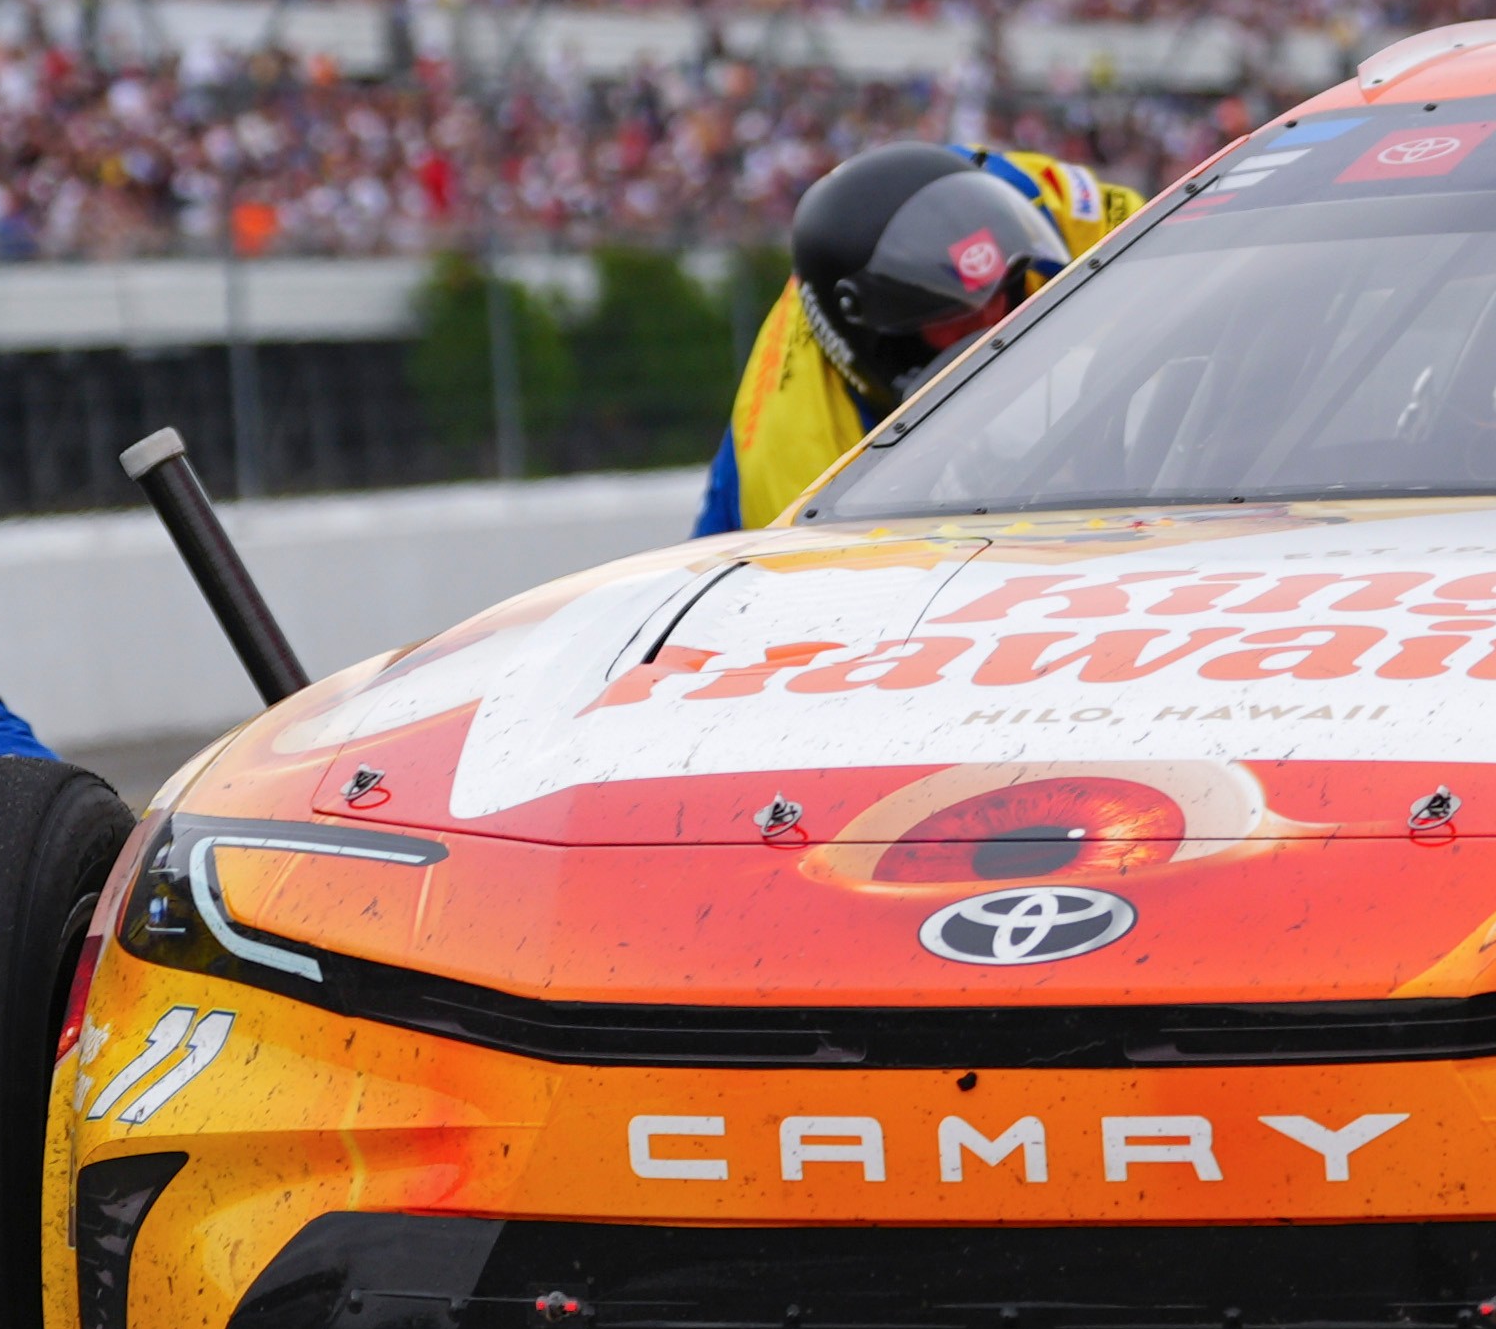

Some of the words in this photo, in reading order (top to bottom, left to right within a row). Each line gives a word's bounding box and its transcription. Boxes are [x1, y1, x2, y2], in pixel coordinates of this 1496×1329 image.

[1284, 545, 1401, 561] EST
[959, 705, 1124, 727] HILO,
[1156, 704, 1390, 725] HAWAII
[86, 1005, 237, 1125] 11
[627, 1113, 1410, 1182] CAMRY
